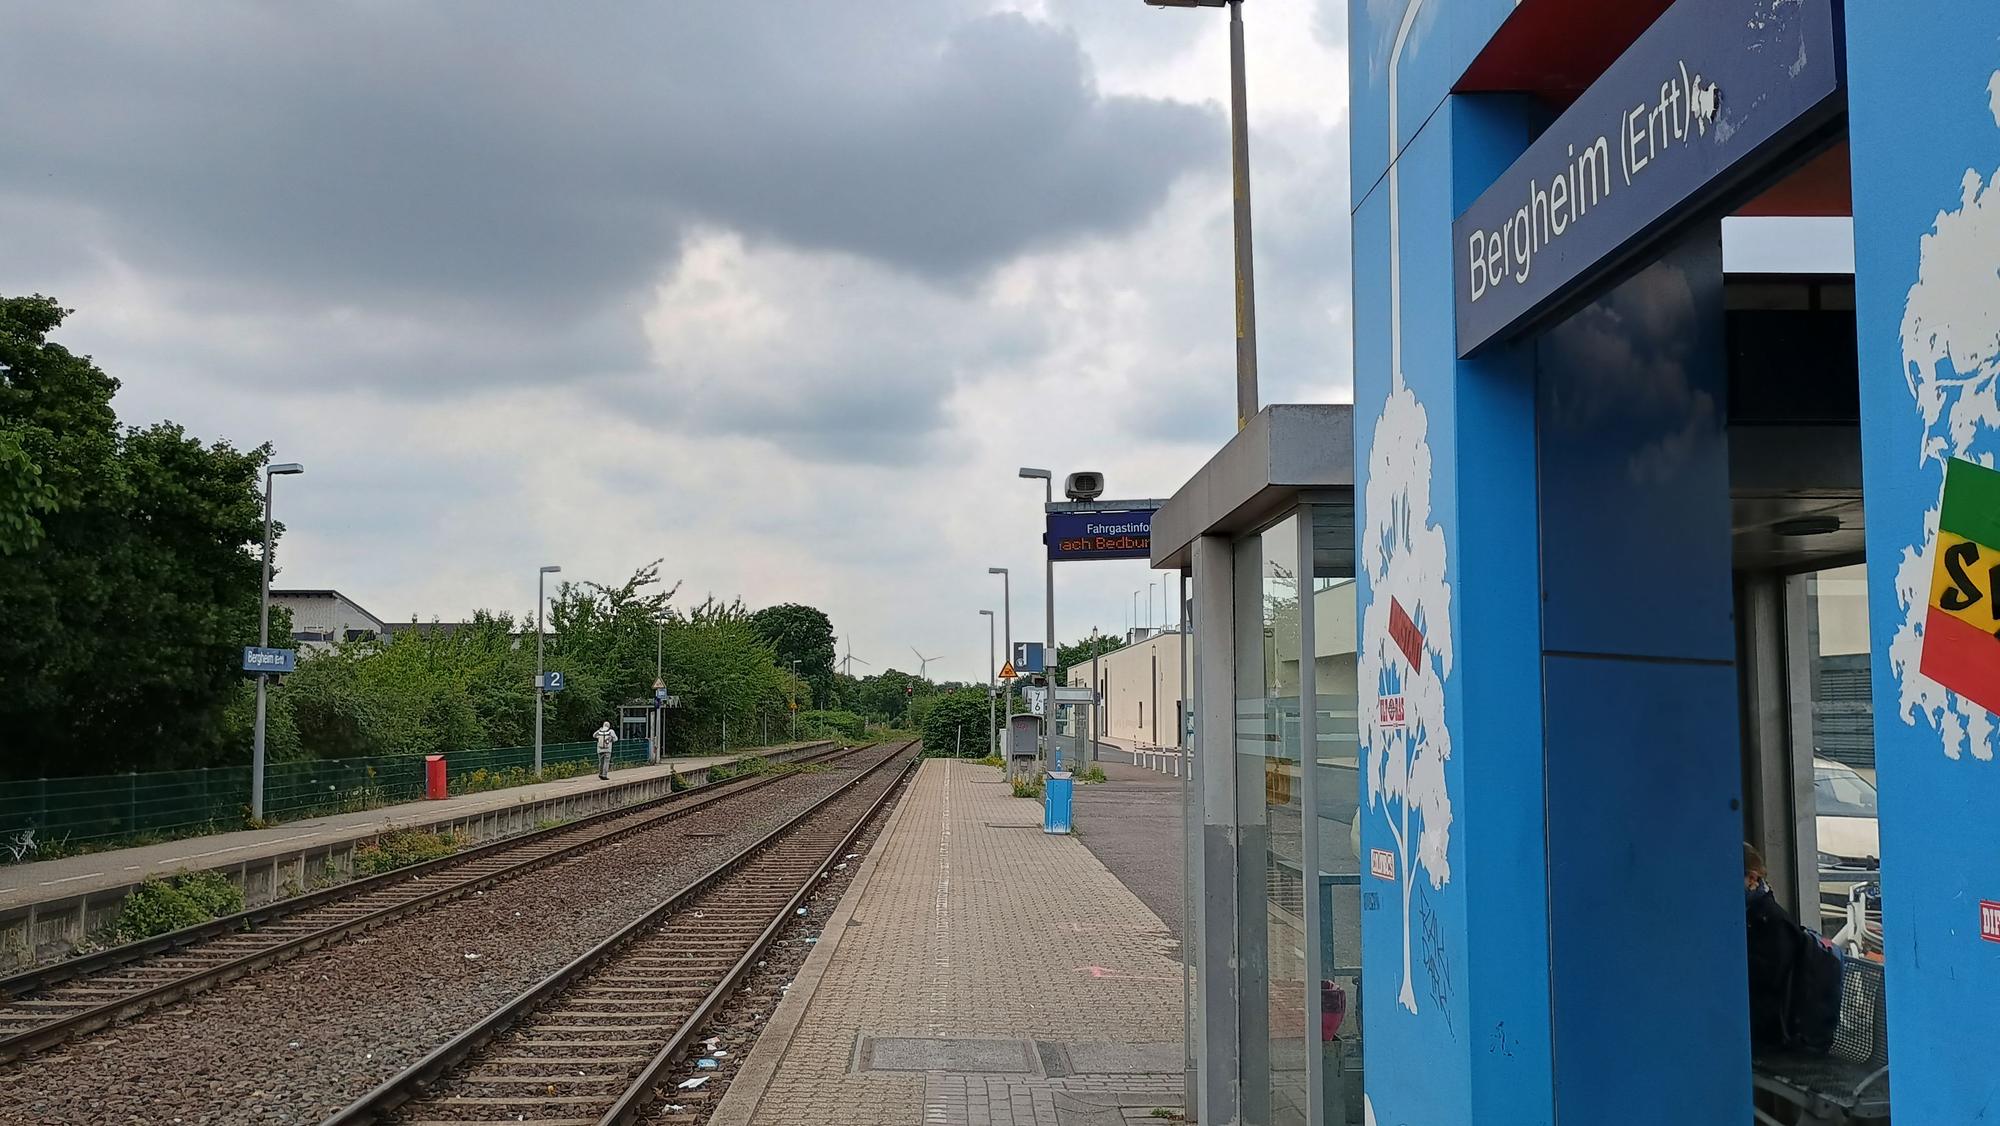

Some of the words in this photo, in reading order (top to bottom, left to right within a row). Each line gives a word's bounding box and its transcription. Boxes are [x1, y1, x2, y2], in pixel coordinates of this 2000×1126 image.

[1469, 135, 1610, 303] Bergheim
[1621, 60, 1690, 185] (Erft)
[1940, 542, 2000, 621] S
[248, 651, 274, 666] Bergheim
[1018, 643, 1028, 665] 1
[550, 672, 560, 686] 2
